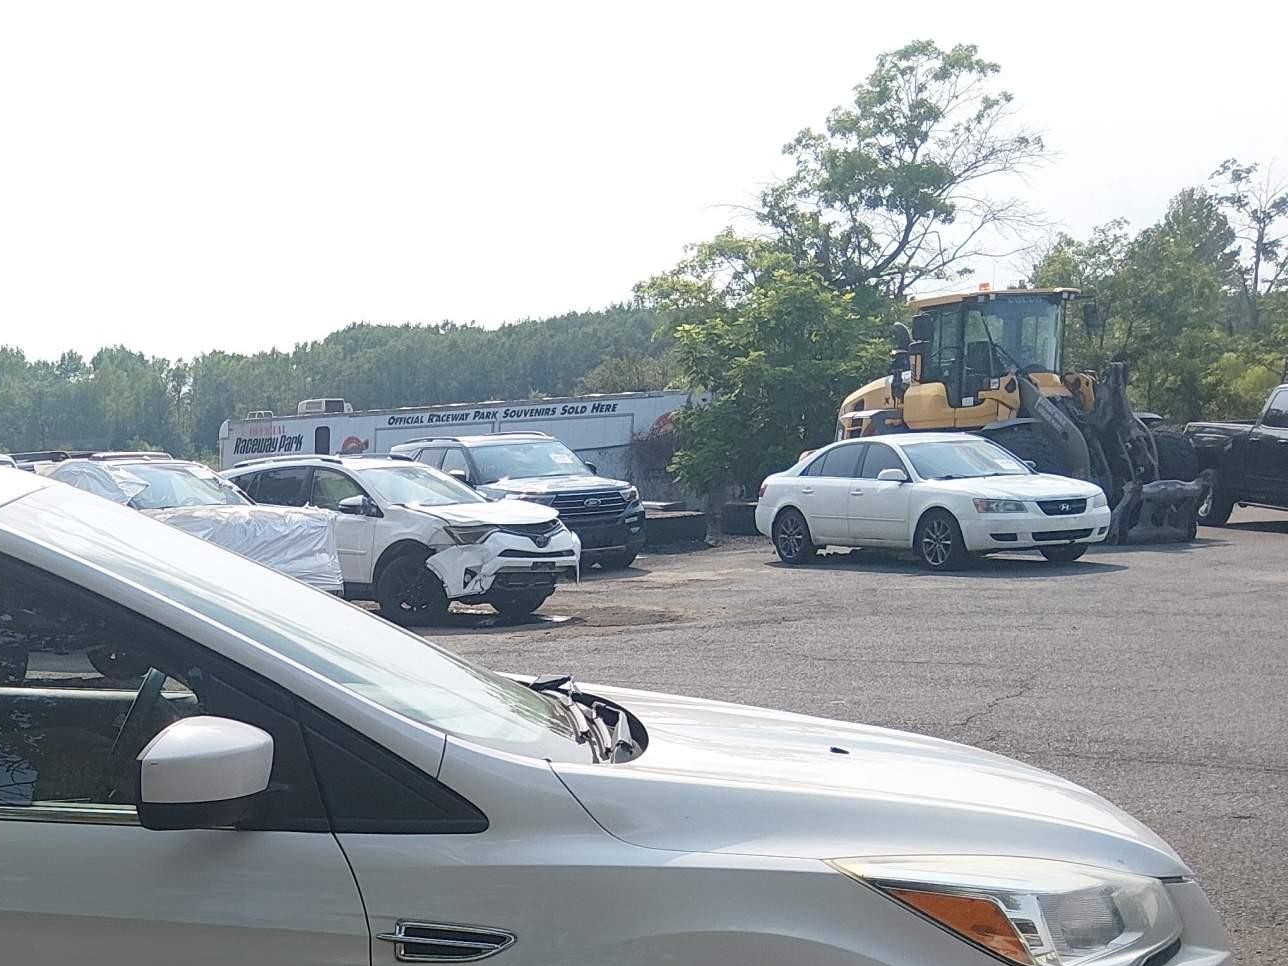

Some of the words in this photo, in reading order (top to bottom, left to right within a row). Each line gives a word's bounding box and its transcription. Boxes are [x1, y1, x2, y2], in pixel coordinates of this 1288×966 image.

[387, 416, 424, 425] OFFICIAL
[427, 413, 470, 423] RACEWAY
[472, 411, 498, 420] PARK
[502, 407, 557, 418] SOUVENIRS
[560, 405, 587, 415] SOLD
[591, 403, 618, 413] HERE
[233, 437, 279, 455] Raceway
[278, 433, 304, 452] Park
